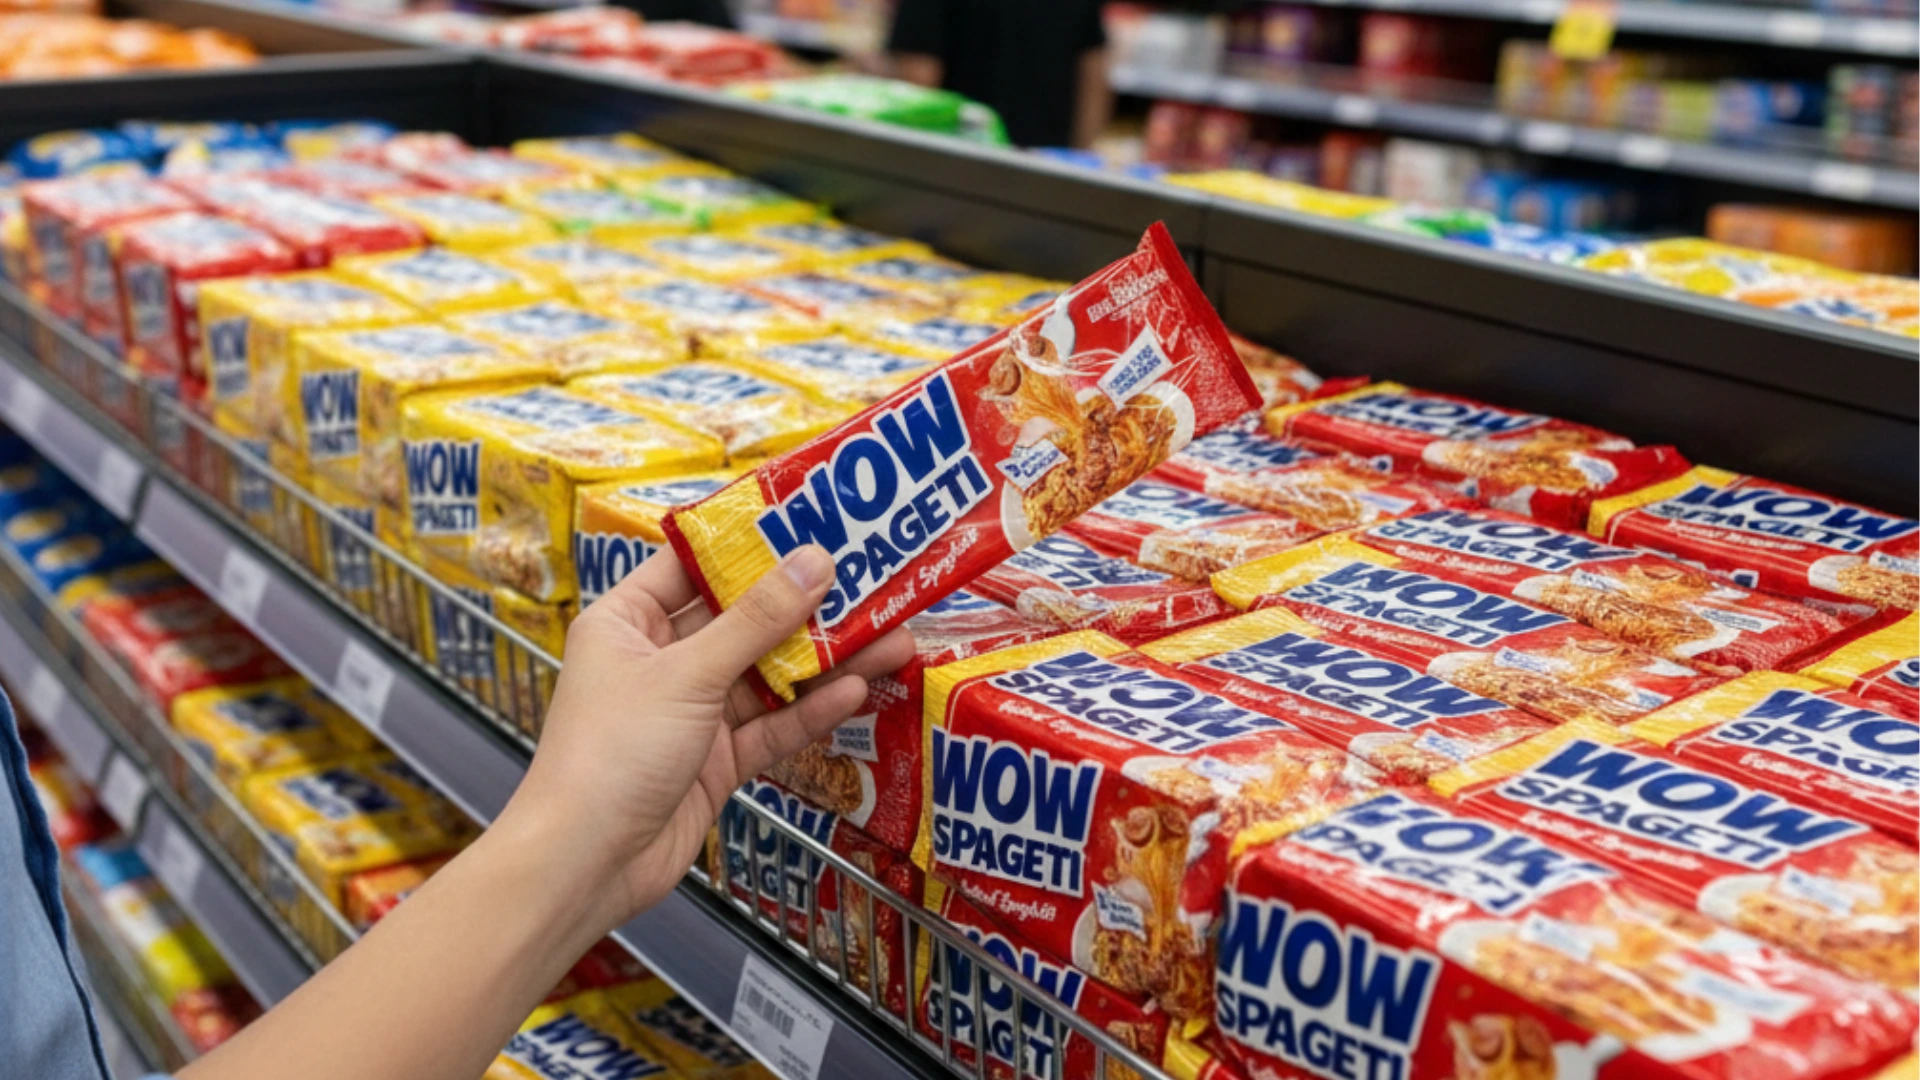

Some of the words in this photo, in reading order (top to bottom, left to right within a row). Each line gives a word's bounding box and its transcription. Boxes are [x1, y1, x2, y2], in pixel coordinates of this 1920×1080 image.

[403, 440, 480, 498] WOW
[757, 374, 966, 560] WOW
[820, 454, 989, 622] SPAGETI
[1674, 485, 1919, 540] WOW
[1317, 562, 1572, 635] WOW
[995, 671, 1207, 752] SPAGETI
[1032, 651, 1290, 738] WOW
[1207, 653, 1432, 728] SPAGETI
[1240, 632, 1512, 718] WOW
[932, 727, 1098, 842] WOW
[1504, 777, 1784, 863] SPAGETI
[1535, 740, 1862, 847] WOW
[934, 813, 1083, 891] SPAGETI
[1217, 901, 1432, 1045] WOW
[532, 1012, 666, 1080] WOW
[1216, 982, 1406, 1080] SPAGETI
